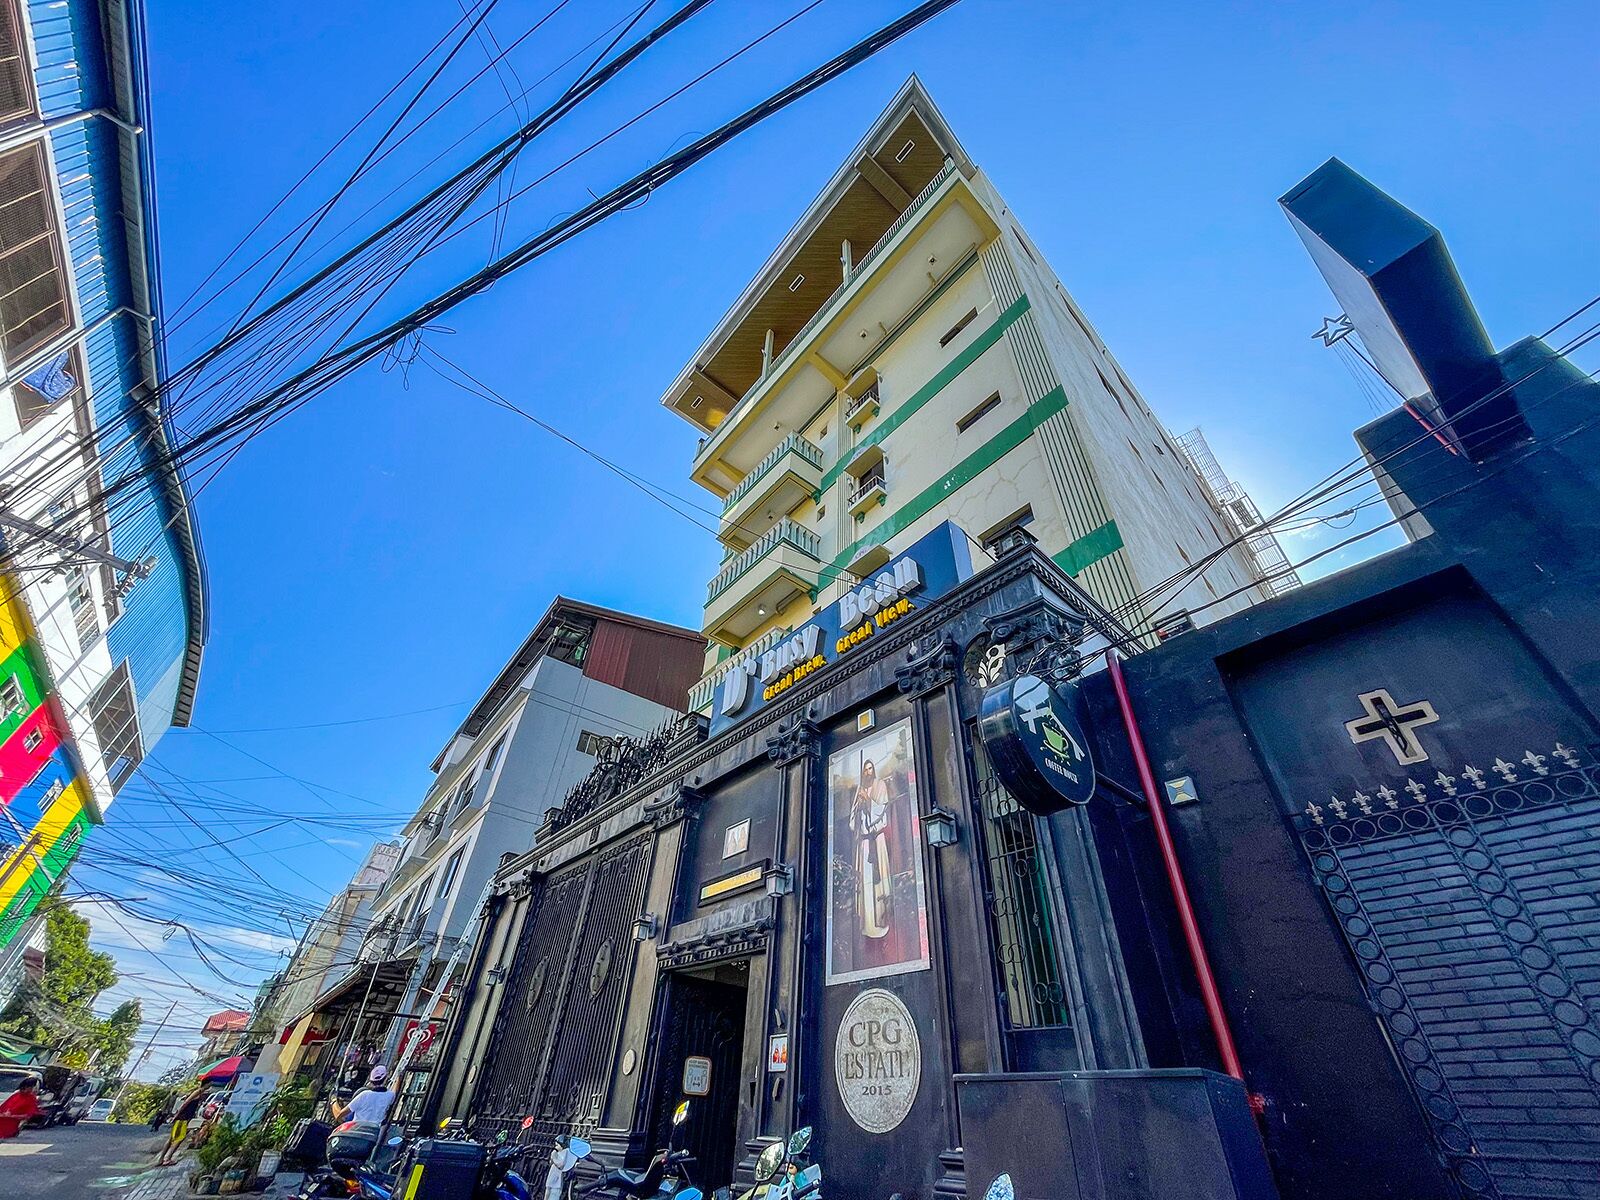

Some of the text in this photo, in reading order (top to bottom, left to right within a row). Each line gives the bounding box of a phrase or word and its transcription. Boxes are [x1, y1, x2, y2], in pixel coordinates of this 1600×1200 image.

[838, 556, 921, 631] Bean
[763, 598, 915, 701] Great Brew. Great View.
[1044, 757, 1079, 785] COFFEE HOUSE
[849, 1018, 902, 1048] CPG
[844, 1049, 911, 1080] ESTATE
[862, 1085, 892, 1096] 2015
